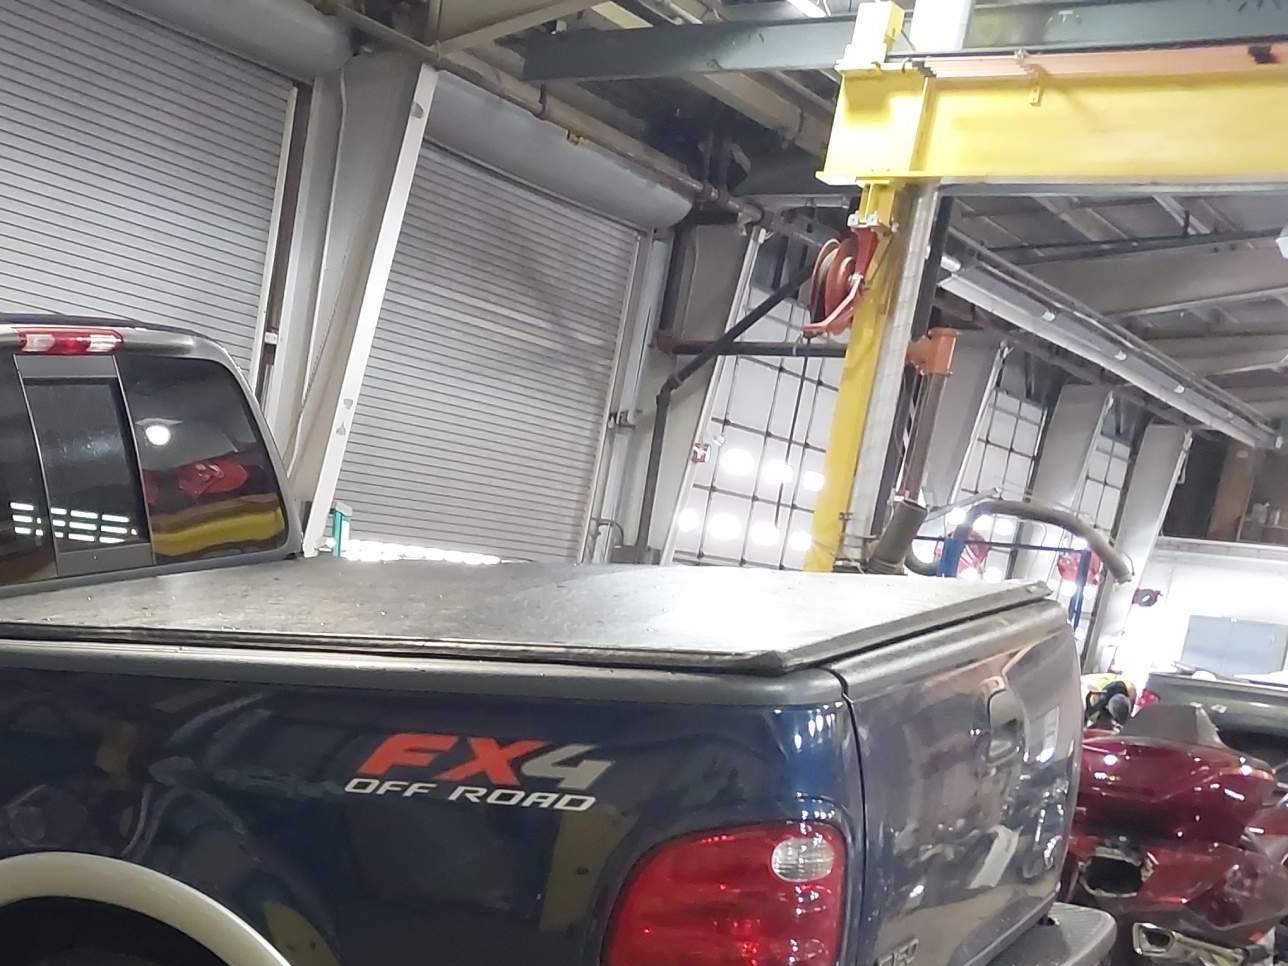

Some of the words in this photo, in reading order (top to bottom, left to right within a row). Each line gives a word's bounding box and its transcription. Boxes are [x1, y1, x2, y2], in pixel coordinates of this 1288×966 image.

[356, 732, 616, 791] FX4
[344, 777, 437, 798] OFF
[448, 785, 597, 812] ROAD
